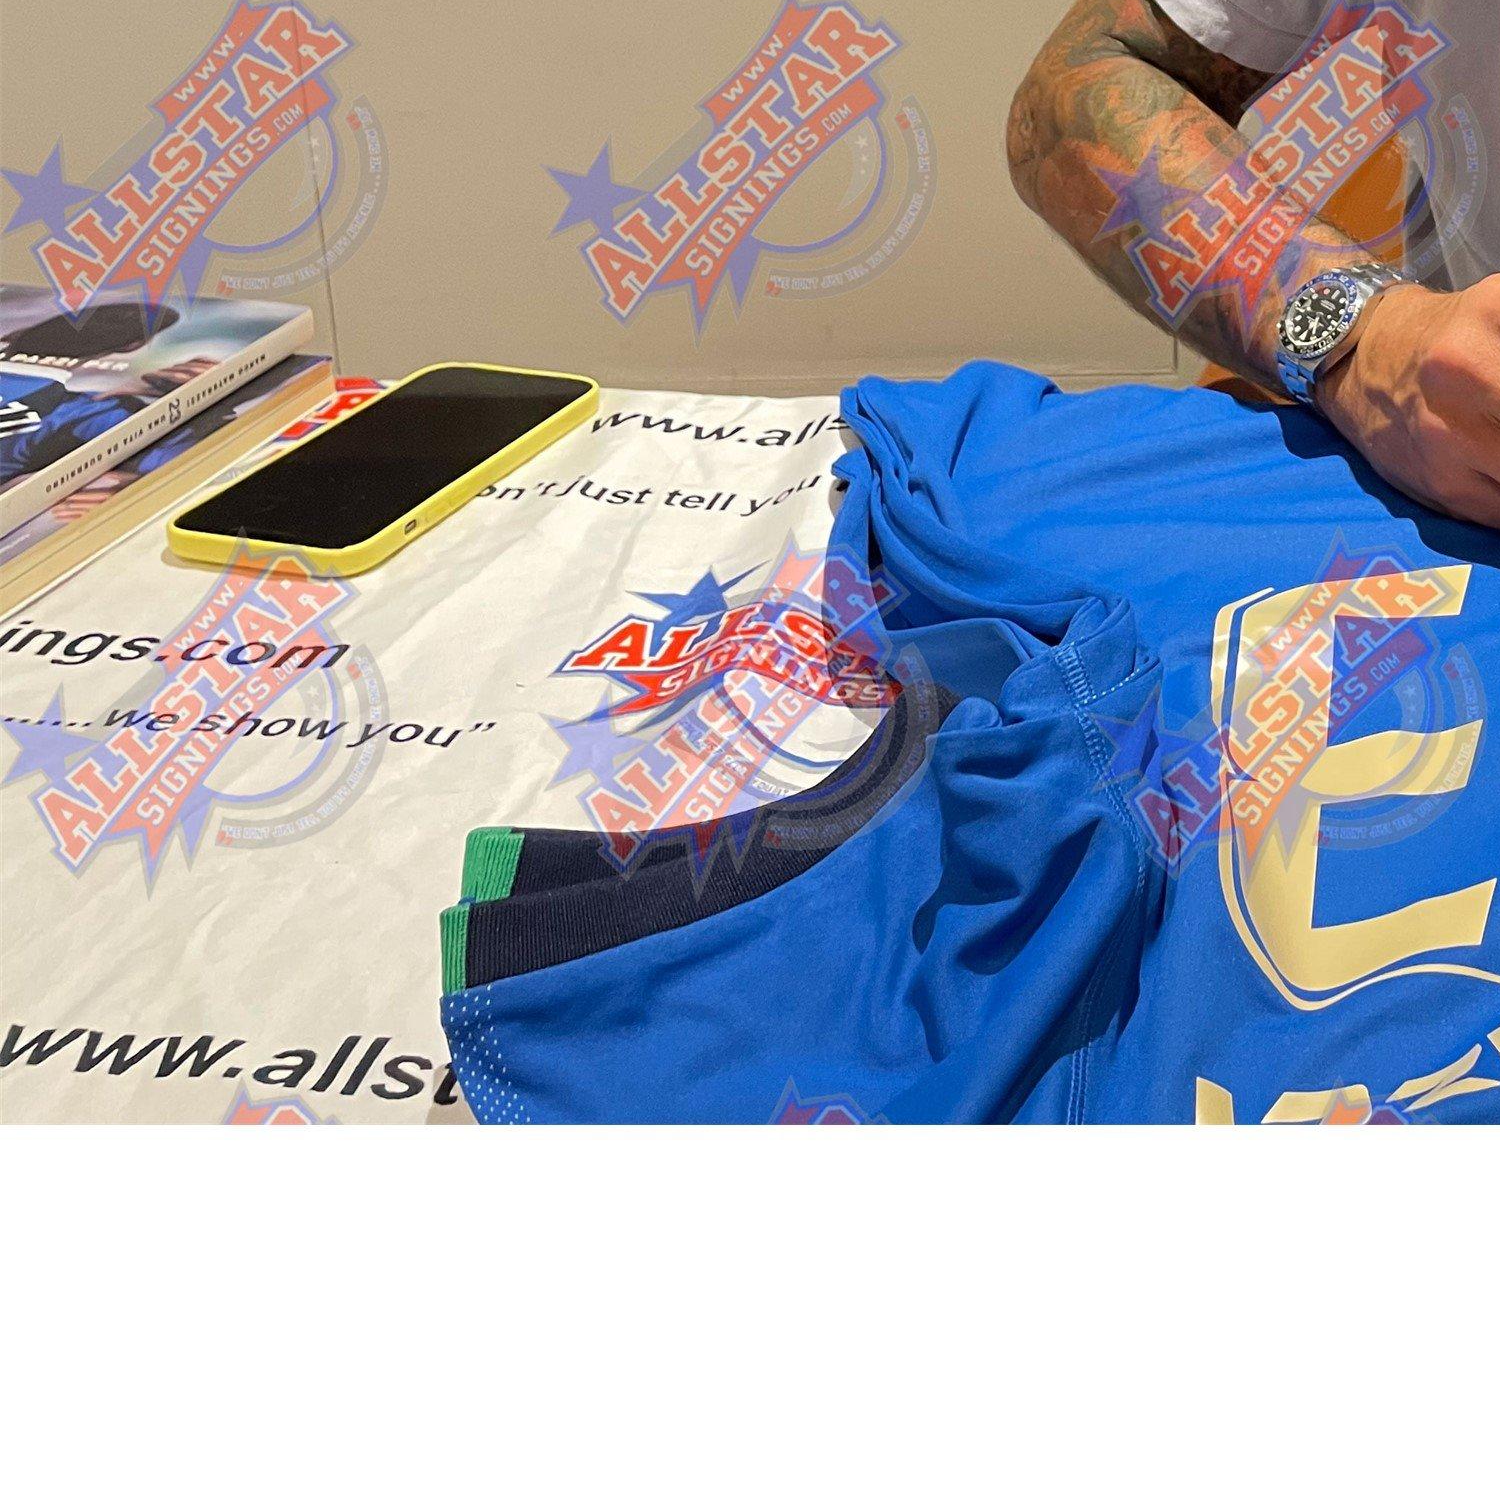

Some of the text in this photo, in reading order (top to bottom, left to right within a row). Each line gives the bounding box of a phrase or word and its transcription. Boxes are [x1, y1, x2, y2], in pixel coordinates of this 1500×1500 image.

[122, 427, 145, 445] VITA
[556, 475, 652, 506] just
[664, 488, 738, 512] tell
[740, 474, 823, 517] you
[199, 702, 338, 739] show
